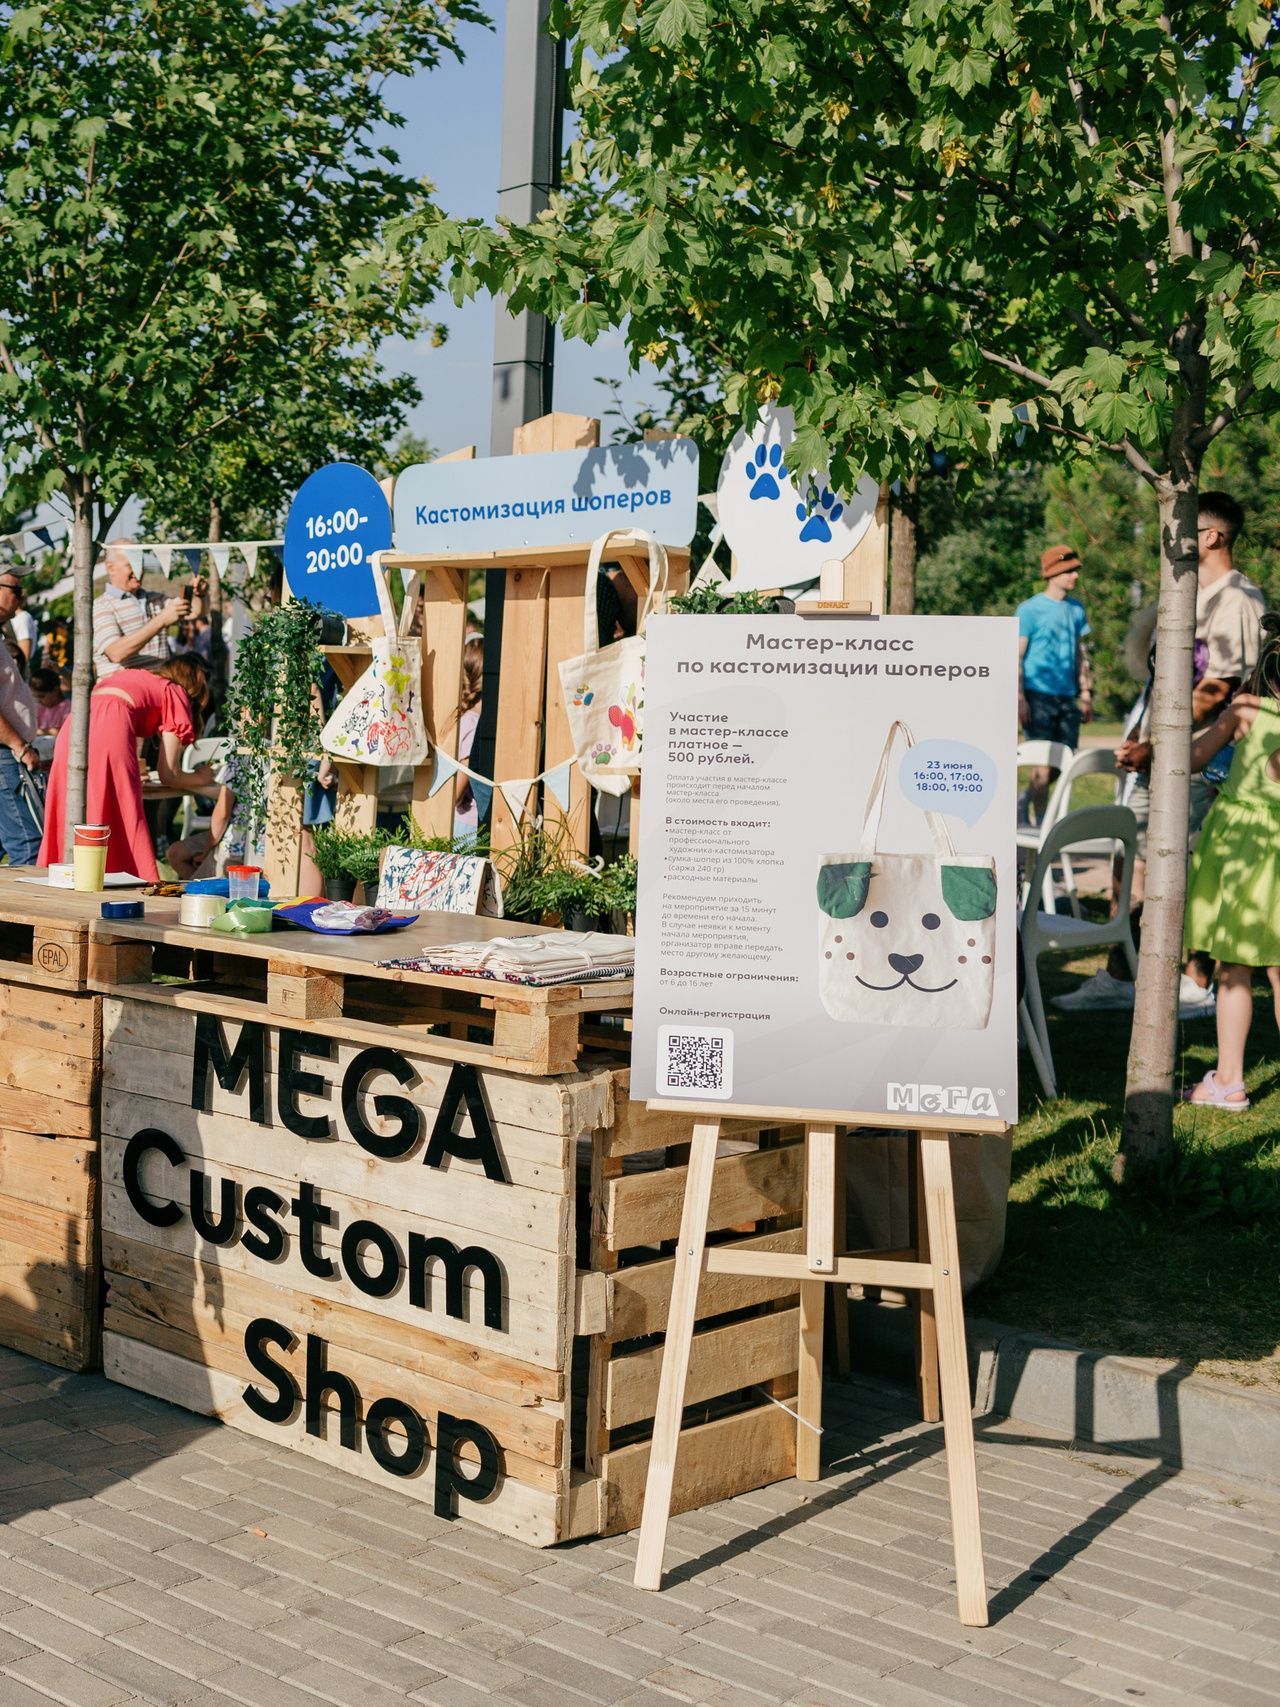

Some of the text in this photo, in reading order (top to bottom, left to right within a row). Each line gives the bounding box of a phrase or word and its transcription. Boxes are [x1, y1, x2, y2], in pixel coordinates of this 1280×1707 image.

[415, 488, 671, 526] Кастомизация шоперов
[305, 507, 368, 539] 16:00-
[306, 542, 363, 574] 20:00
[817, 601, 850, 609] DINART
[745, 633, 914, 654] Мастер-класс
[677, 661, 990, 681] по кастомизации шоперов
[670, 711, 728, 722] Участие
[669, 727, 789, 738] в мастер-классе
[668, 741, 728, 749] платное
[668, 752, 754, 765] 500 рублей.
[927, 760, 940, 769] 23
[734, 776, 787, 784] мастер-классе
[914, 772, 983, 782] 16:00, 17:00,
[916, 783, 983, 792] 18:00, 19:00
[665, 816, 771, 828] В стоимость входит:
[669, 837, 750, 845] профессионального
[669, 846, 775, 856] художника-кастомизатора
[713, 875, 758, 883] материалы
[663, 893, 762, 904] Рекомендуем приходить
[674, 904, 728, 912] мероприятие
[752, 907, 776, 915] минут
[673, 913, 709, 921] времени
[735, 924, 771, 934] моменту
[692, 932, 748, 941] мероприятия,
[661, 940, 712, 949] организатор
[745, 944, 783, 952] передать
[42, 948, 63, 967] EPAL
[686, 951, 719, 959] другому
[721, 953, 772, 962] желающему.
[660, 968, 799, 982] Возрастные ограничения:
[659, 1007, 771, 1020] Онлайн-регистрация
[190, 1013, 509, 1183] MEGA
[122, 1128, 504, 1330] Custom
[242, 1317, 501, 1521] Shop
